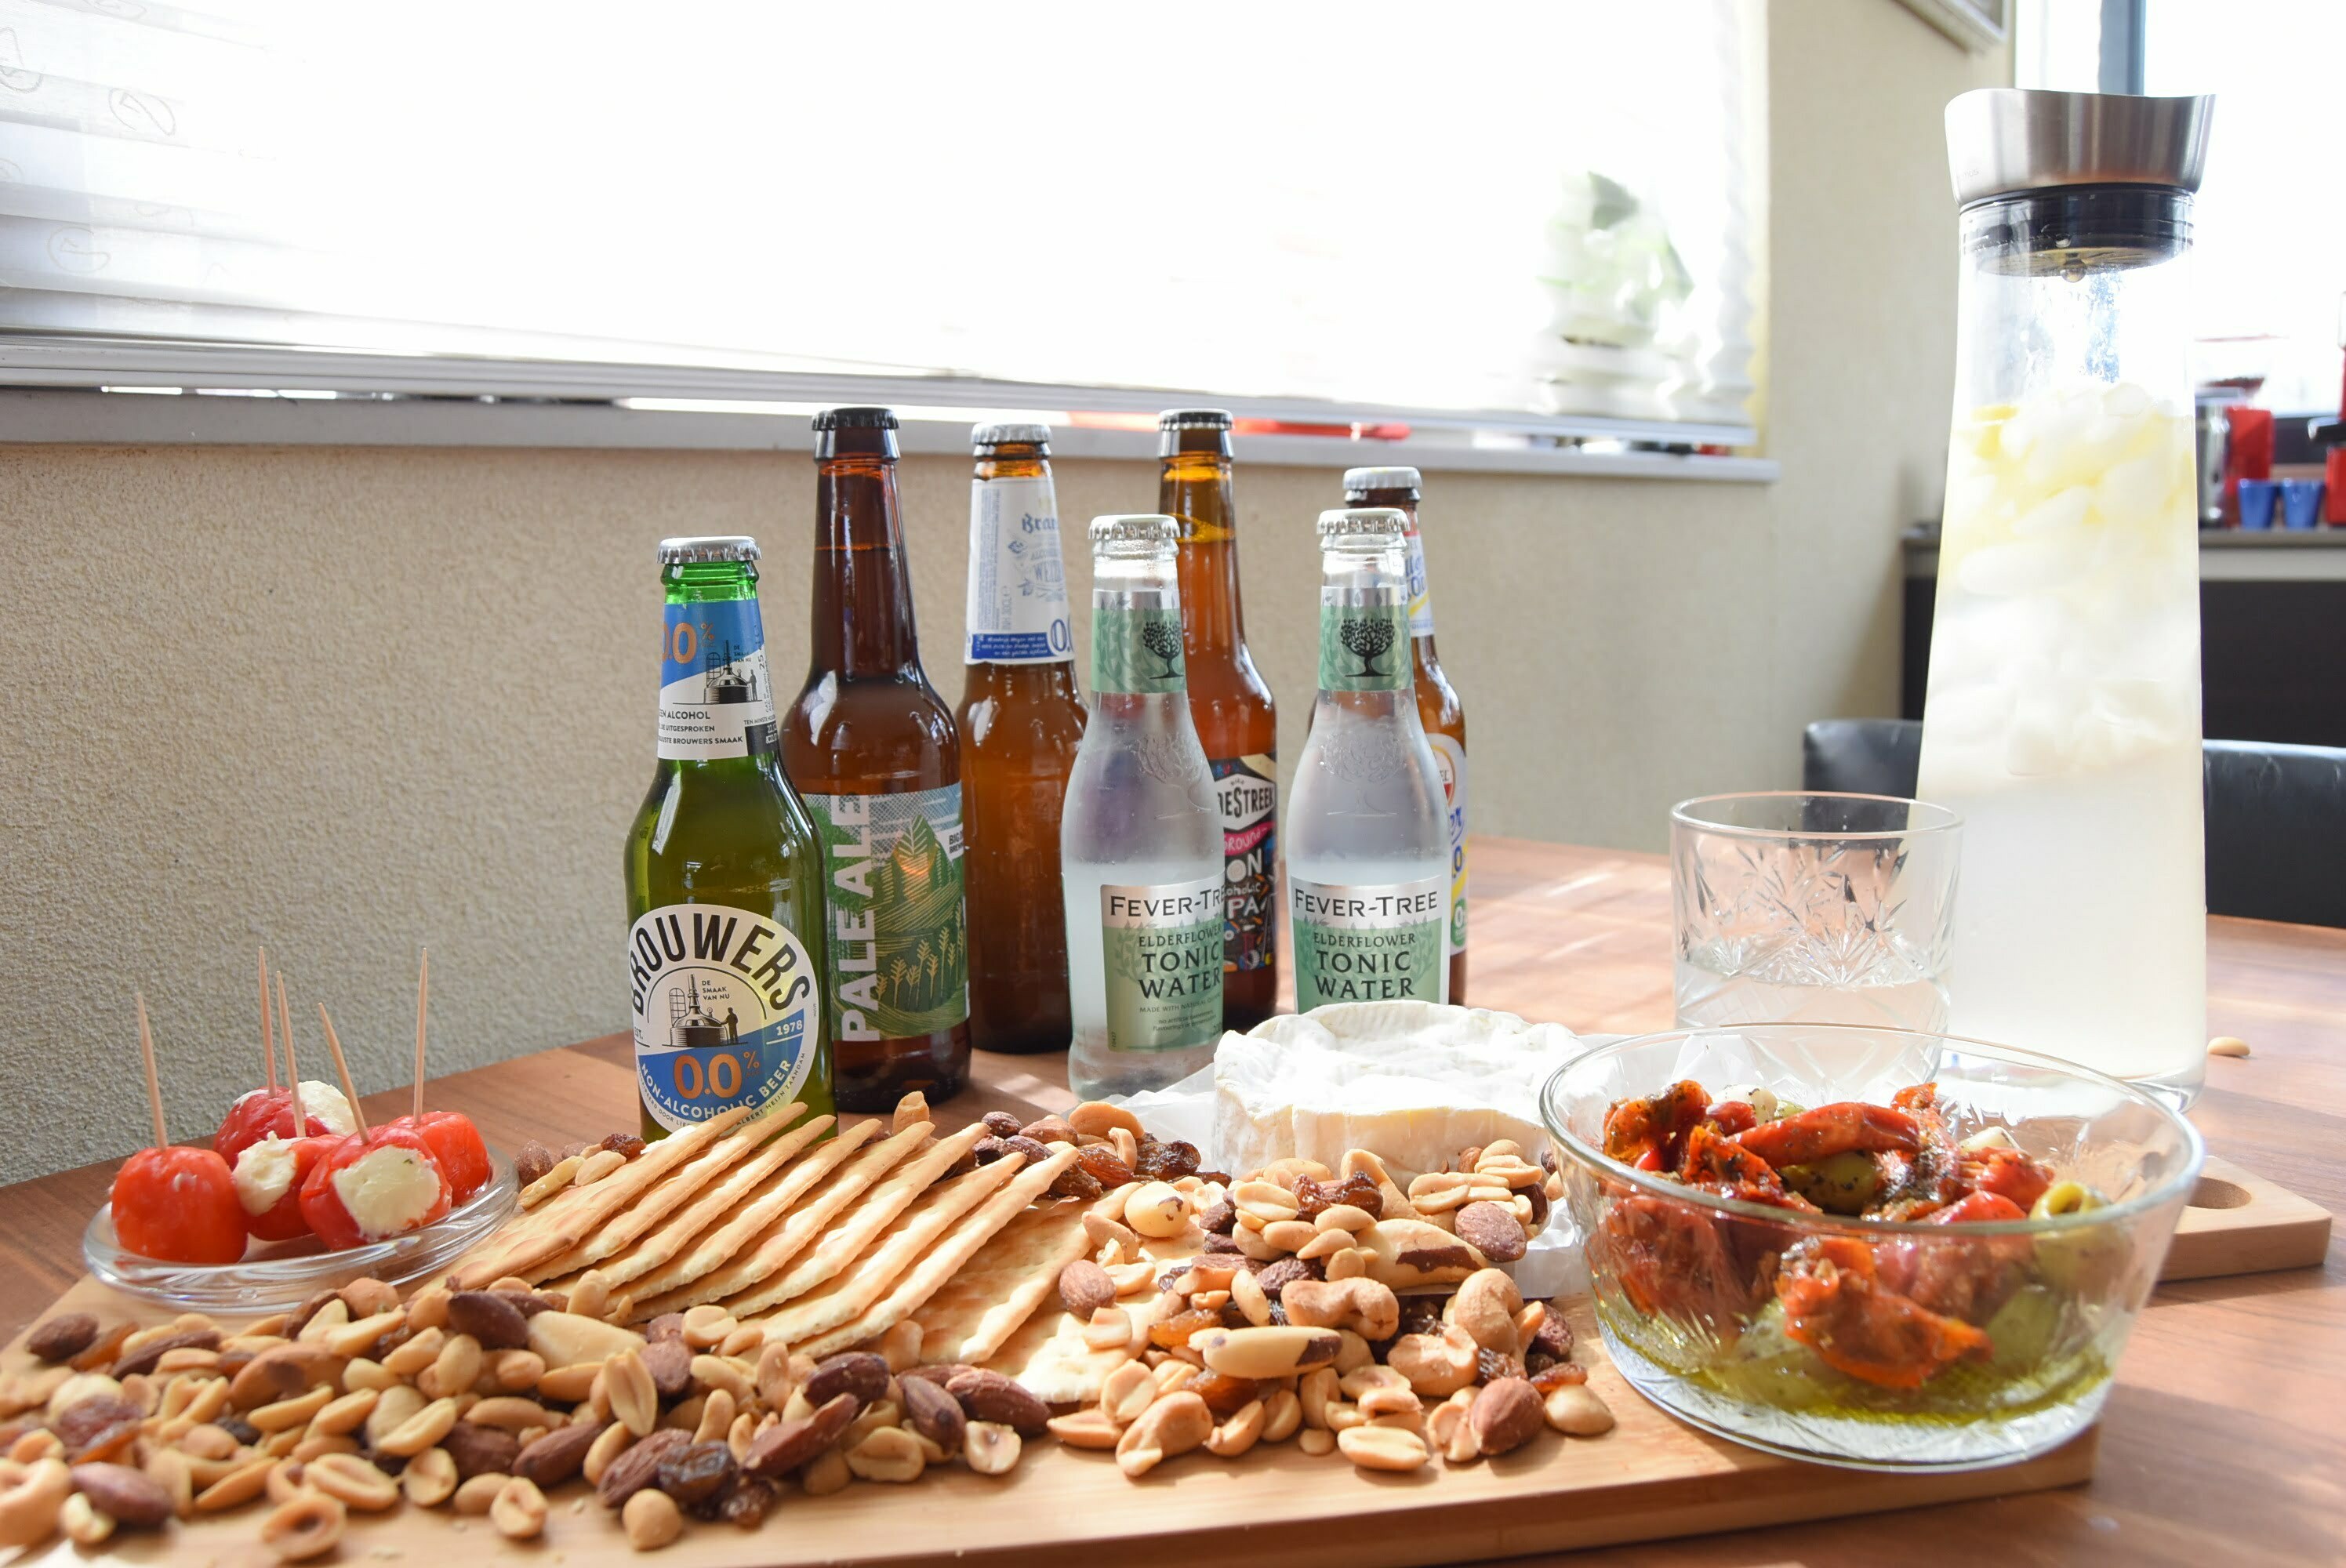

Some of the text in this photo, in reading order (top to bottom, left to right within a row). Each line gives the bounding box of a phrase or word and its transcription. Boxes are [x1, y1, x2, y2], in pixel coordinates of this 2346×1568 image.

[666, 710, 711, 720] ALCOHOL
[1295, 887, 1438, 918] FEVER-TREE
[830, 795, 881, 1043] PALE ALE
[1139, 924, 1222, 947] ELDERFLOWER
[1313, 932, 1417, 948] ELDERFLOWER
[630, 913, 811, 1016] BROUWERS
[1141, 942, 1220, 973] TONIC
[1316, 949, 1411, 975] TONIC
[1138, 967, 1221, 1000] WATER
[1314, 975, 1416, 1000] WATER
[776, 1019, 804, 1036] 1978
[659, 1109, 674, 1122] DOOR
[736, 1109, 764, 1126] ALBERT
[765, 1091, 786, 1109] HEIJN
[785, 1052, 806, 1090] ZAANDAM
[757, 1059, 792, 1098] BEER
